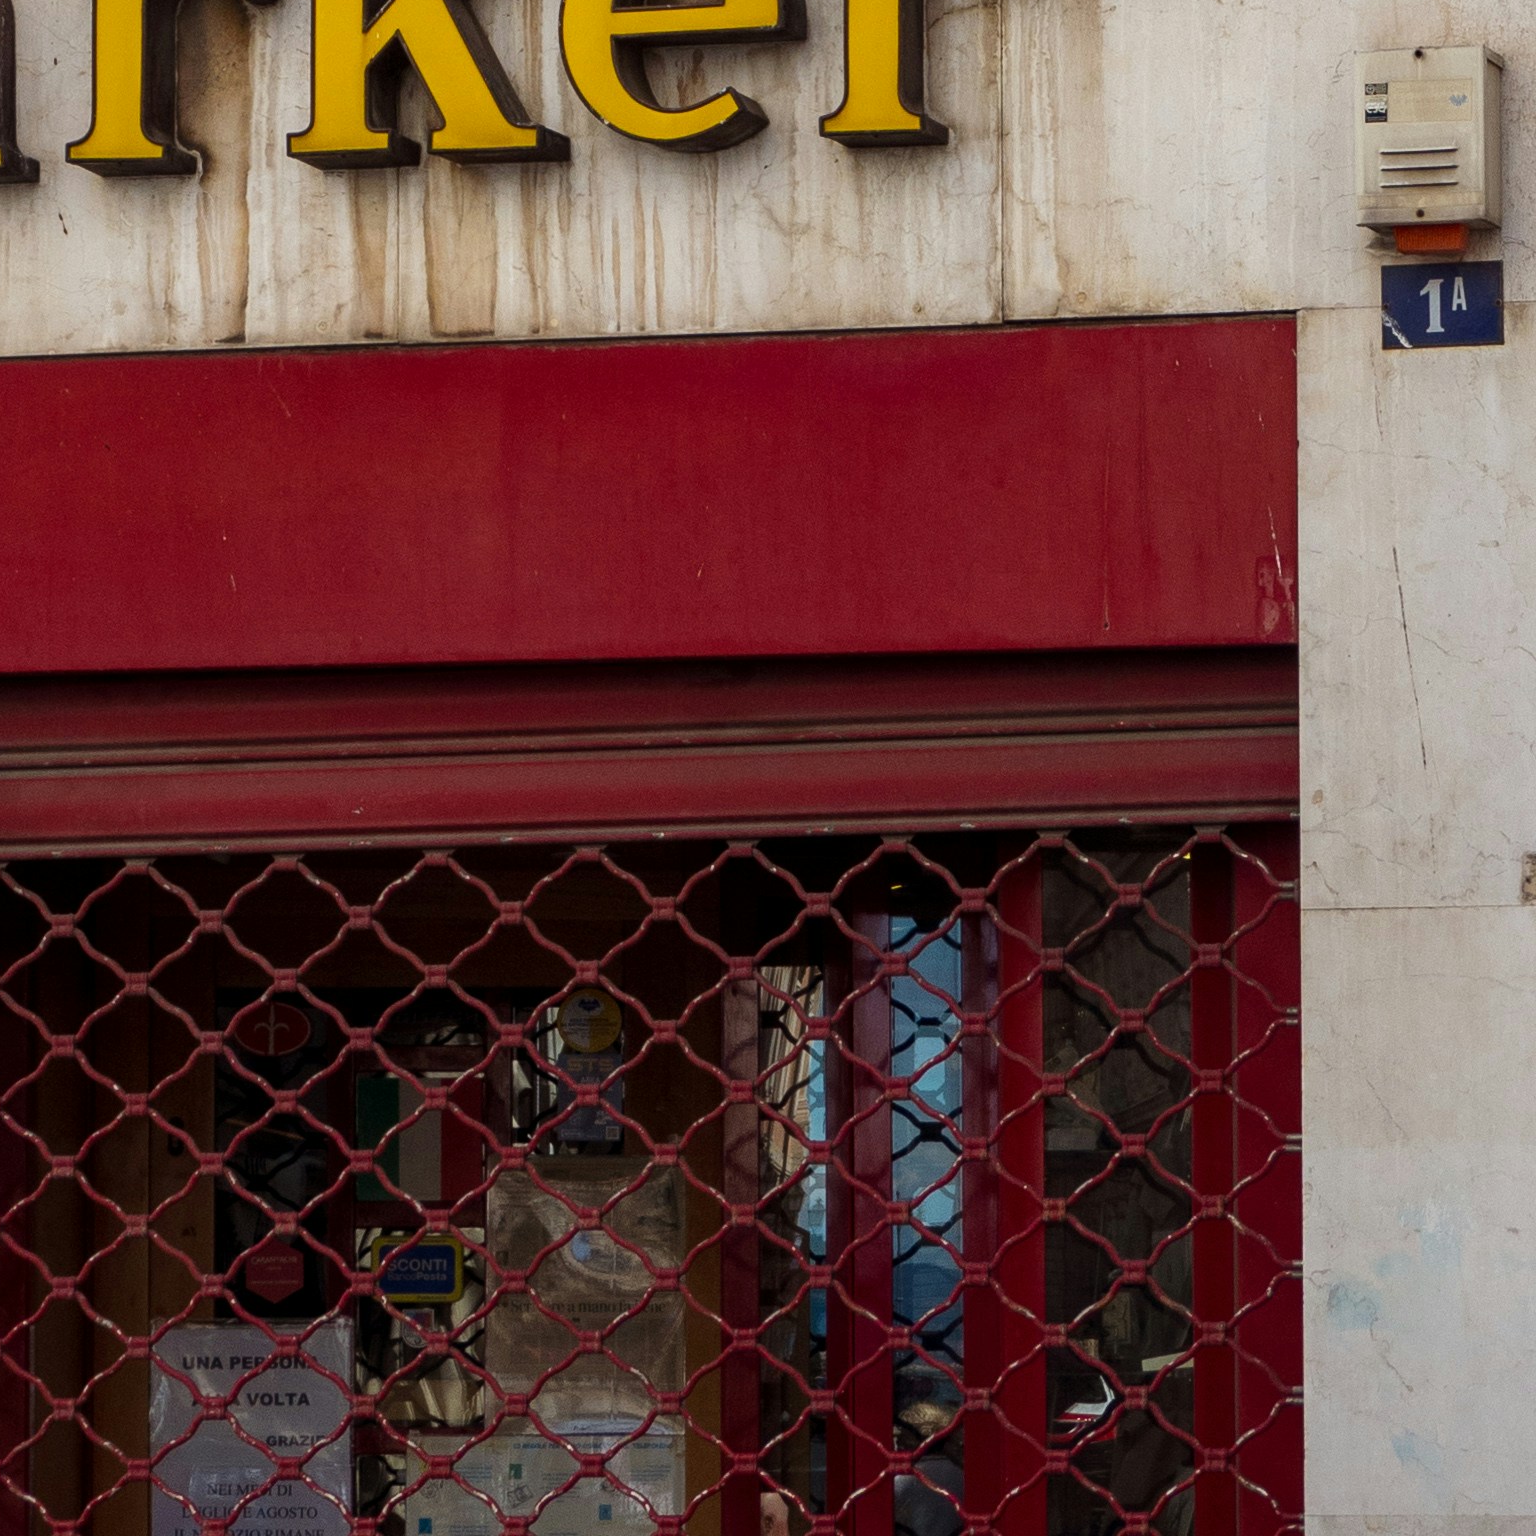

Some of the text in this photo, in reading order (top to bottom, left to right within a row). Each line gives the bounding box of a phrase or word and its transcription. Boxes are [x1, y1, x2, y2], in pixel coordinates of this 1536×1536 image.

[1419, 276, 1468, 334] 1A
[387, 1258, 447, 1272] SCONTI
[182, 1355, 317, 1370] UNA PERSON
[246, 1392, 310, 1406] VOLTA
[207, 1484, 229, 1496] NEI
[277, 1484, 293, 1496] DI
[255, 1506, 318, 1519] AGOSTO
